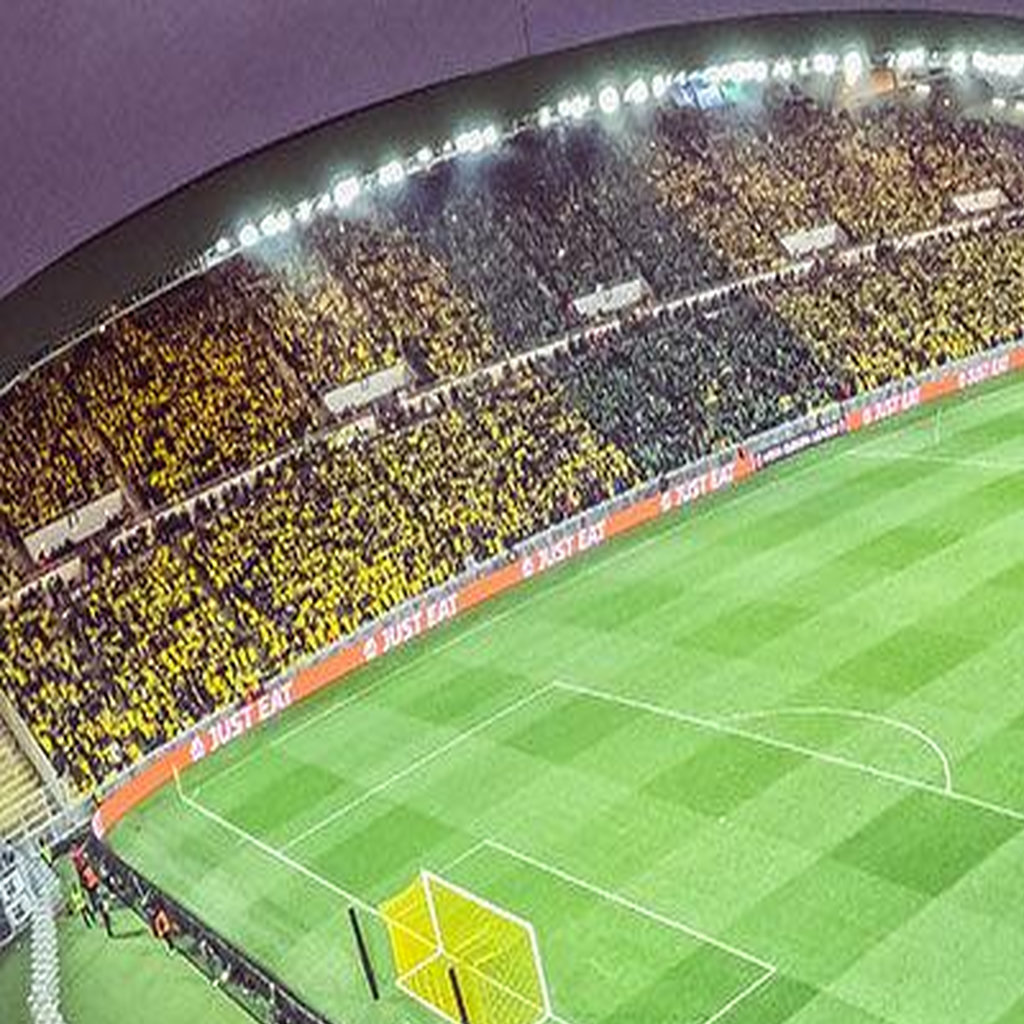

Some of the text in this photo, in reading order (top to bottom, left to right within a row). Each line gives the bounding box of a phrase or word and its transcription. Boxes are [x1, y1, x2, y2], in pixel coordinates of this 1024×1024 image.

[674, 462, 735, 506] JUST EAT
[539, 518, 606, 570] JUST EAT
[381, 594, 458, 652] JUST EAT
[207, 684, 294, 752] JUST EAT
